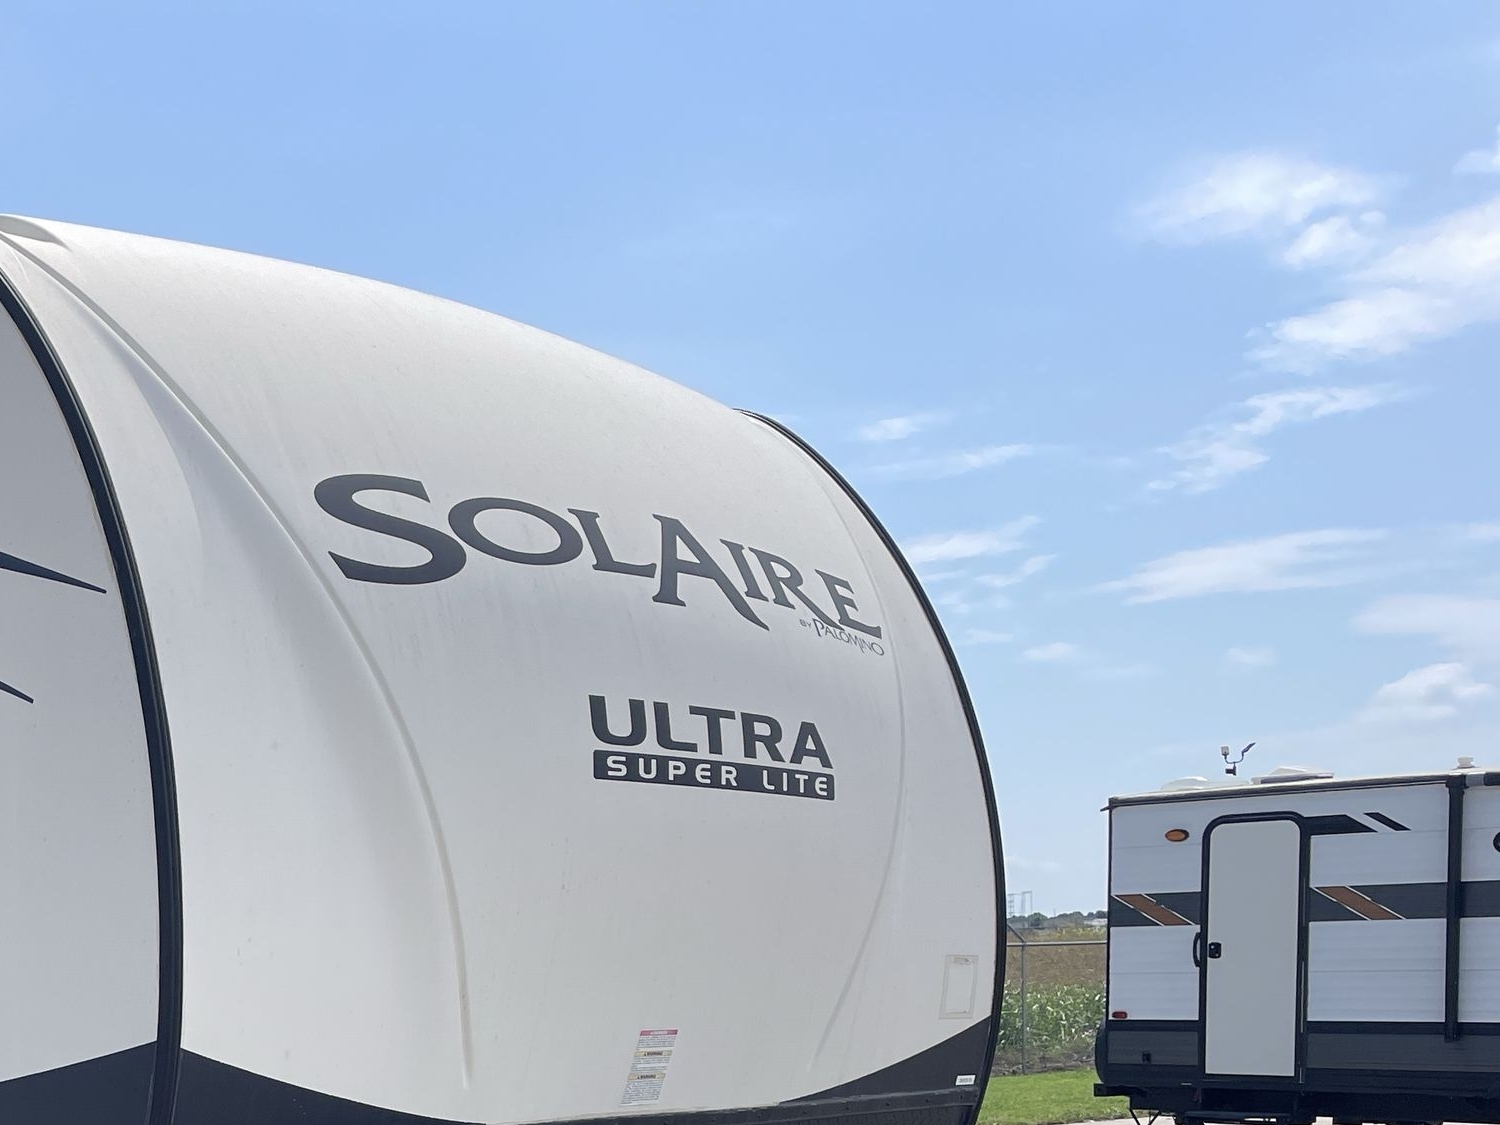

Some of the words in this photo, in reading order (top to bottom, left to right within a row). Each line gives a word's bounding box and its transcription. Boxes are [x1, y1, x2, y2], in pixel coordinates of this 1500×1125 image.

[313, 473, 882, 639] SOLAIRE
[812, 617, 885, 656] PALOMINO
[588, 694, 834, 769] ULTRA
[606, 755, 738, 787] SUPER
[762, 769, 829, 796] LITE
